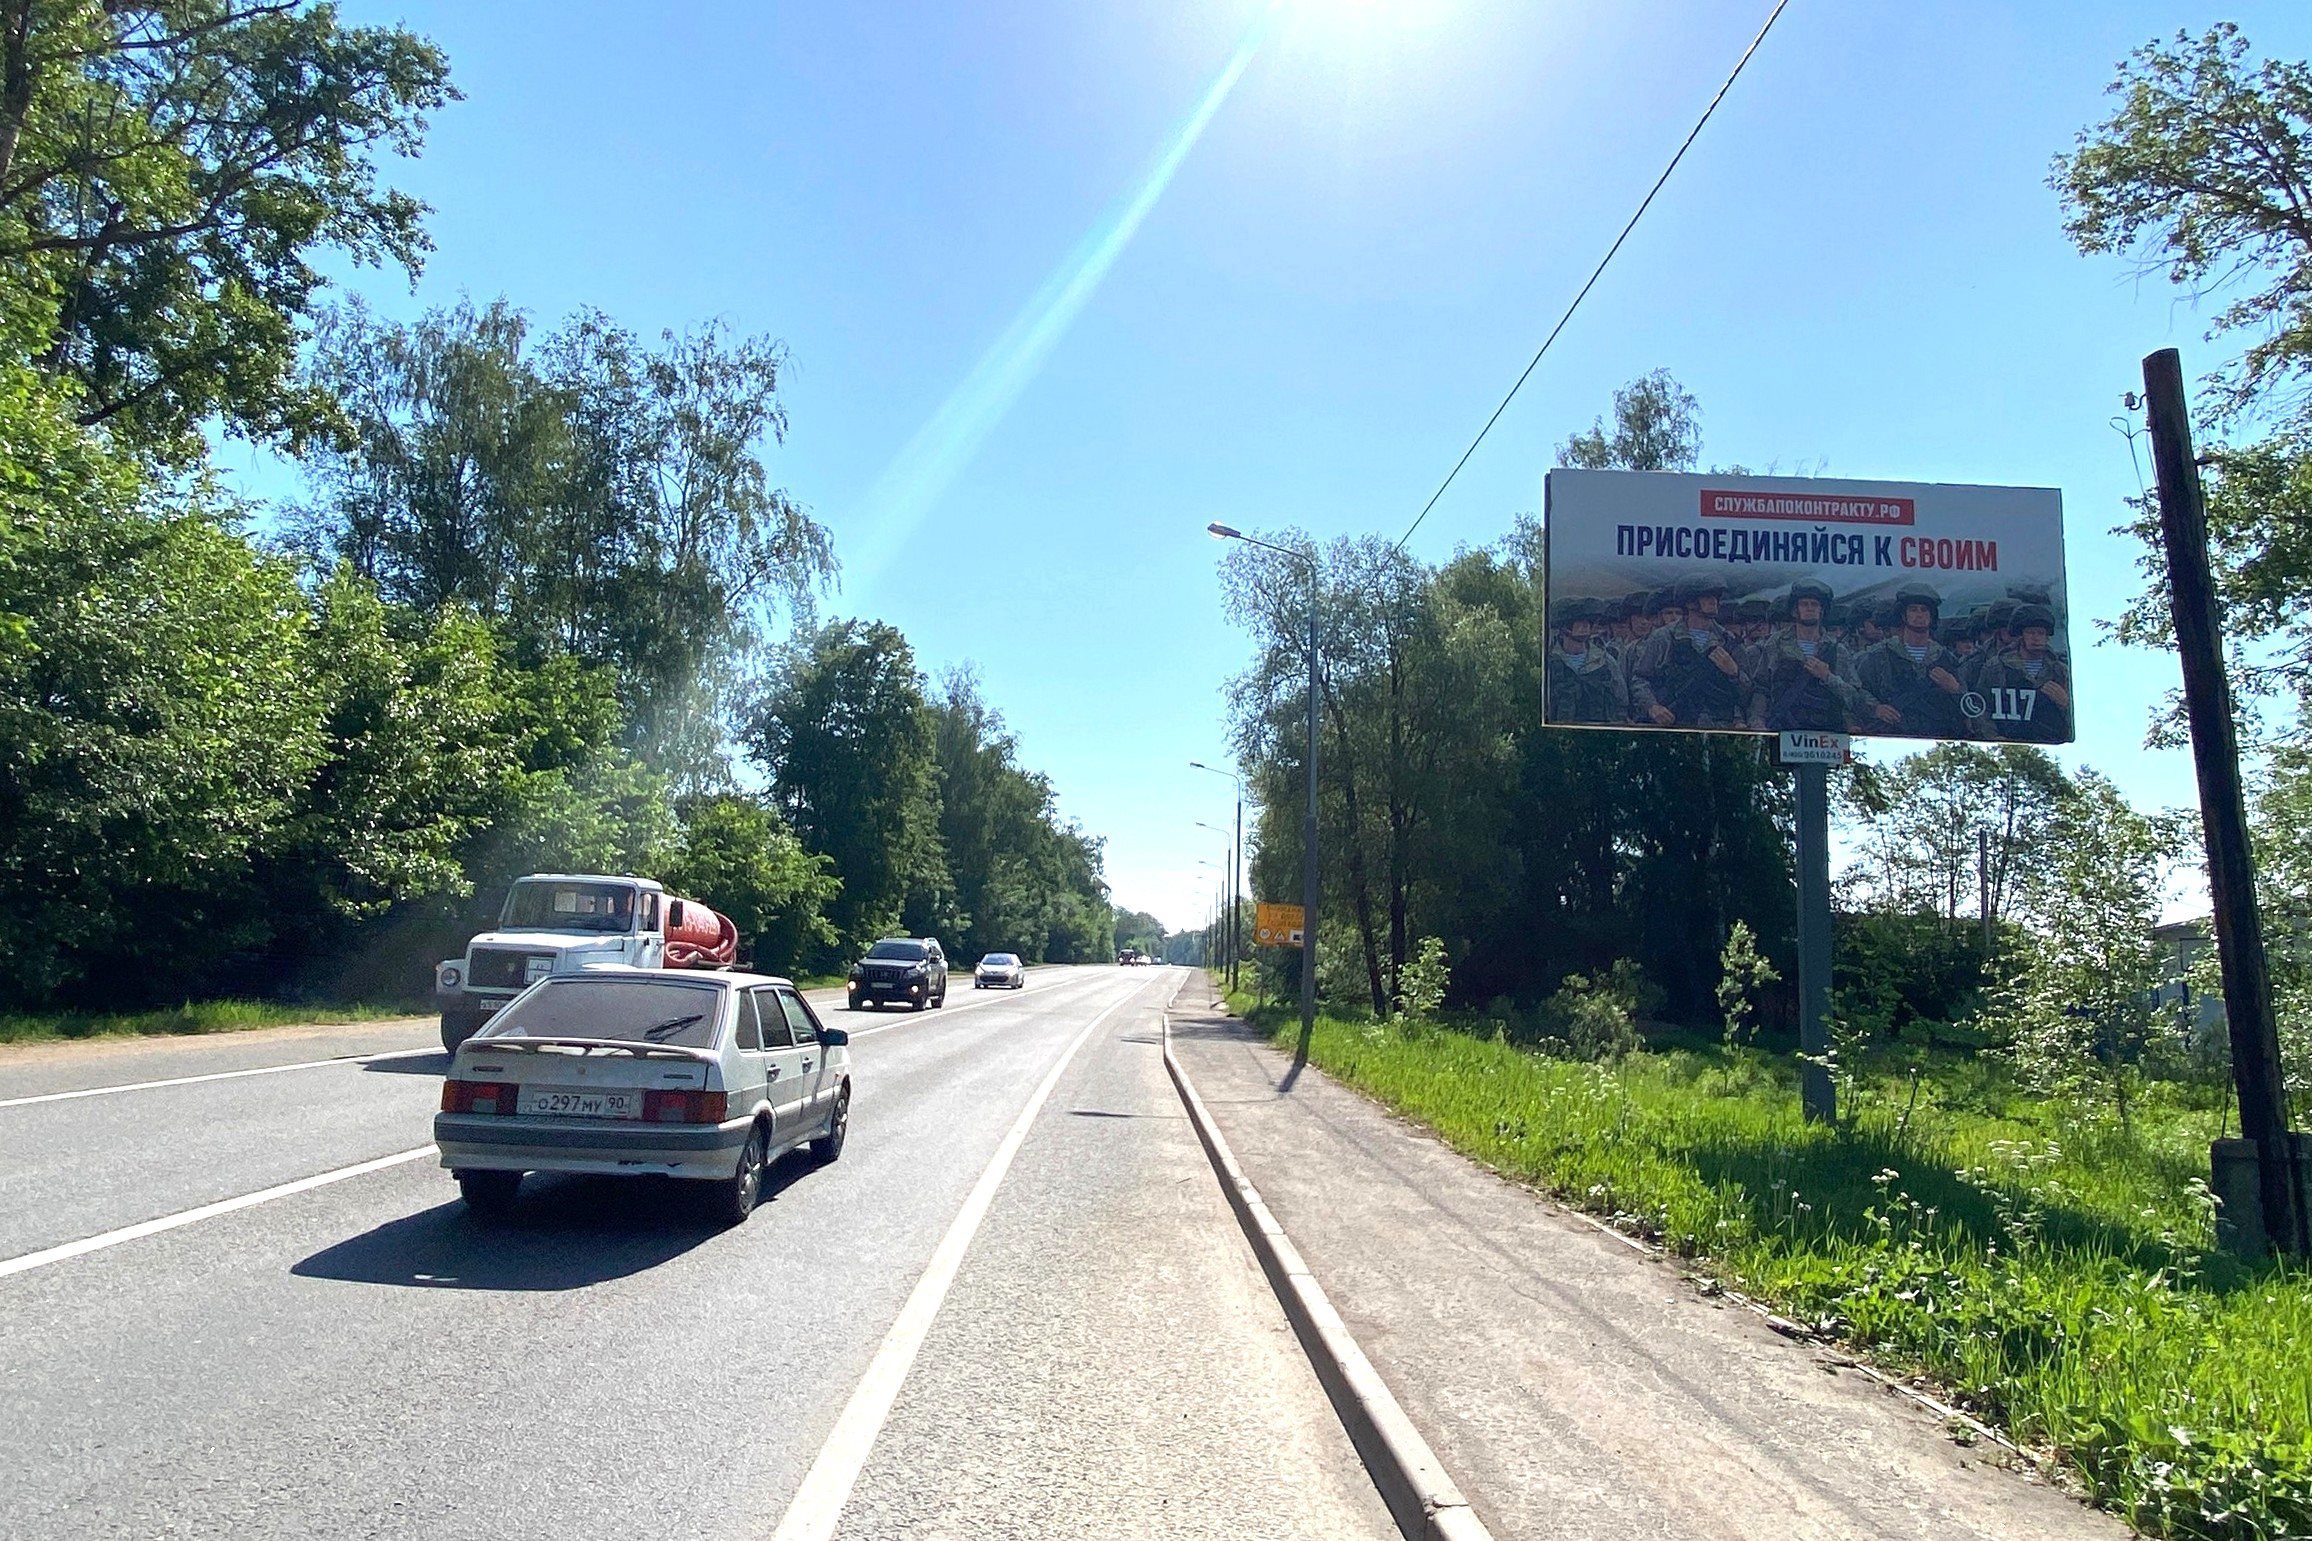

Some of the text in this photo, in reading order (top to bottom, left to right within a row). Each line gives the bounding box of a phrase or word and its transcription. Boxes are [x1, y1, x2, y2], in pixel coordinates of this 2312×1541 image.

[1714, 496, 1901, 519] СЛУЖБАПОКОНТРАКТУ.РФ
[1617, 524, 1998, 572] ПРИСОЕДИНЯЙСЯ К СВОИМ
[1991, 687, 2037, 721] 117
[1790, 733, 1839, 749] VinEx
